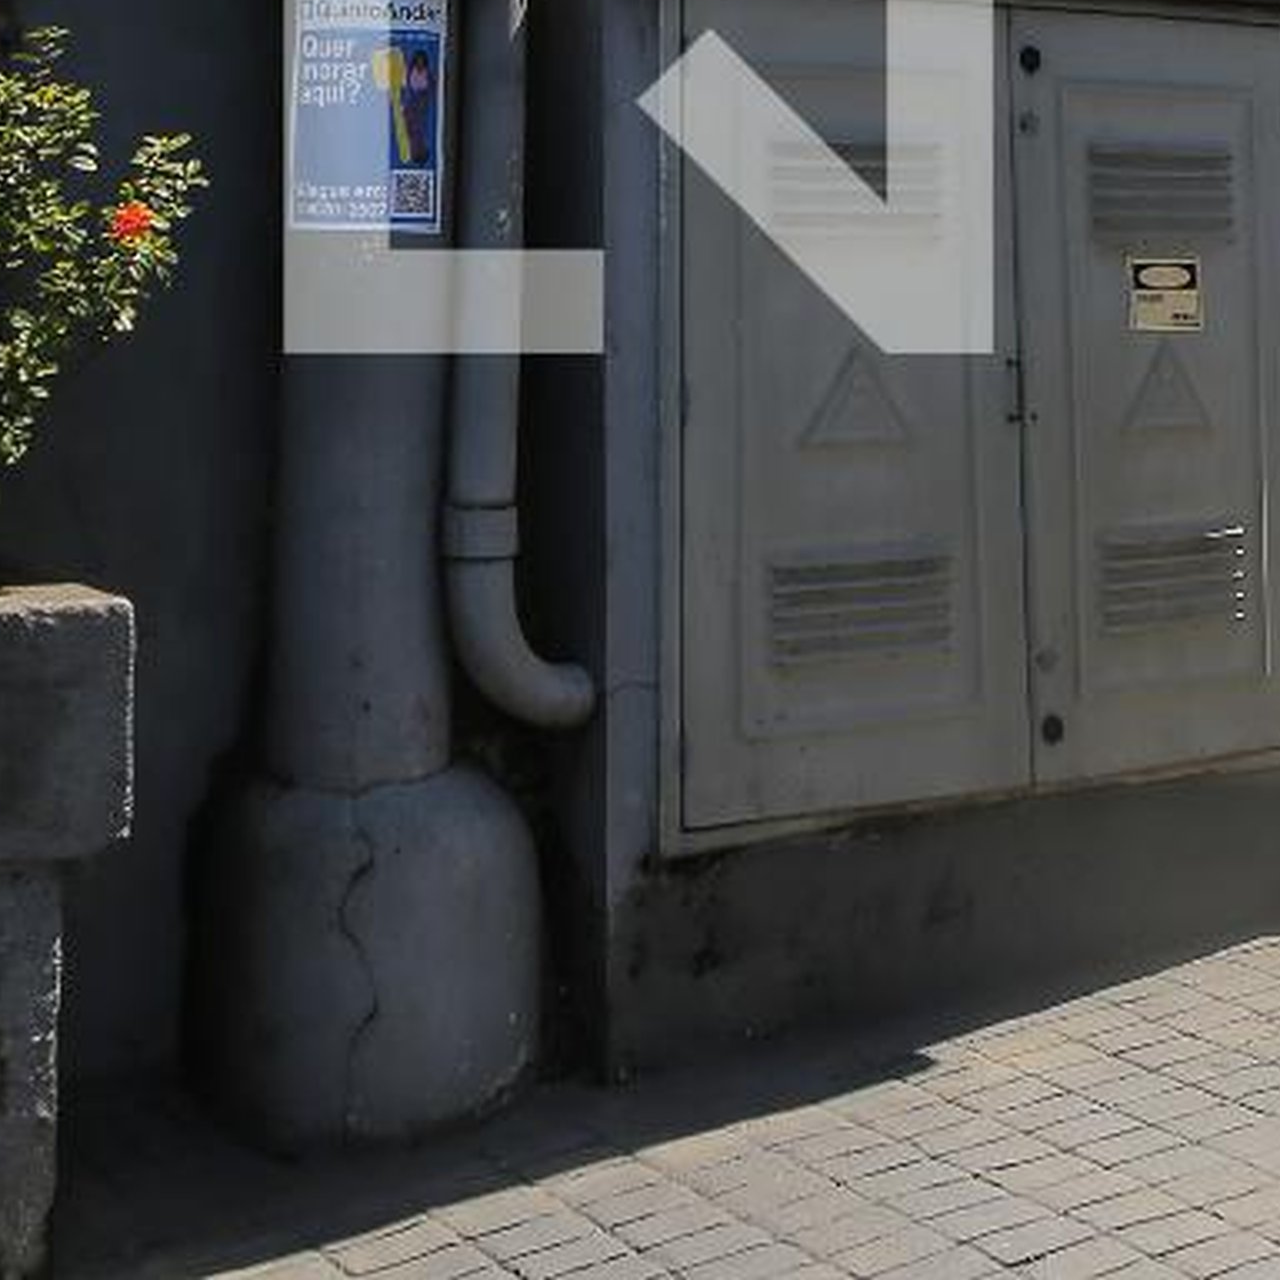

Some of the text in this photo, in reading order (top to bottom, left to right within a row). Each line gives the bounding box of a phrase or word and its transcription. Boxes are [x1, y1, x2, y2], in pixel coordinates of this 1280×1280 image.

[302, 34, 352, 59] Quer
[302, 62, 368, 81] morar
[299, 80, 362, 108] aqui?
